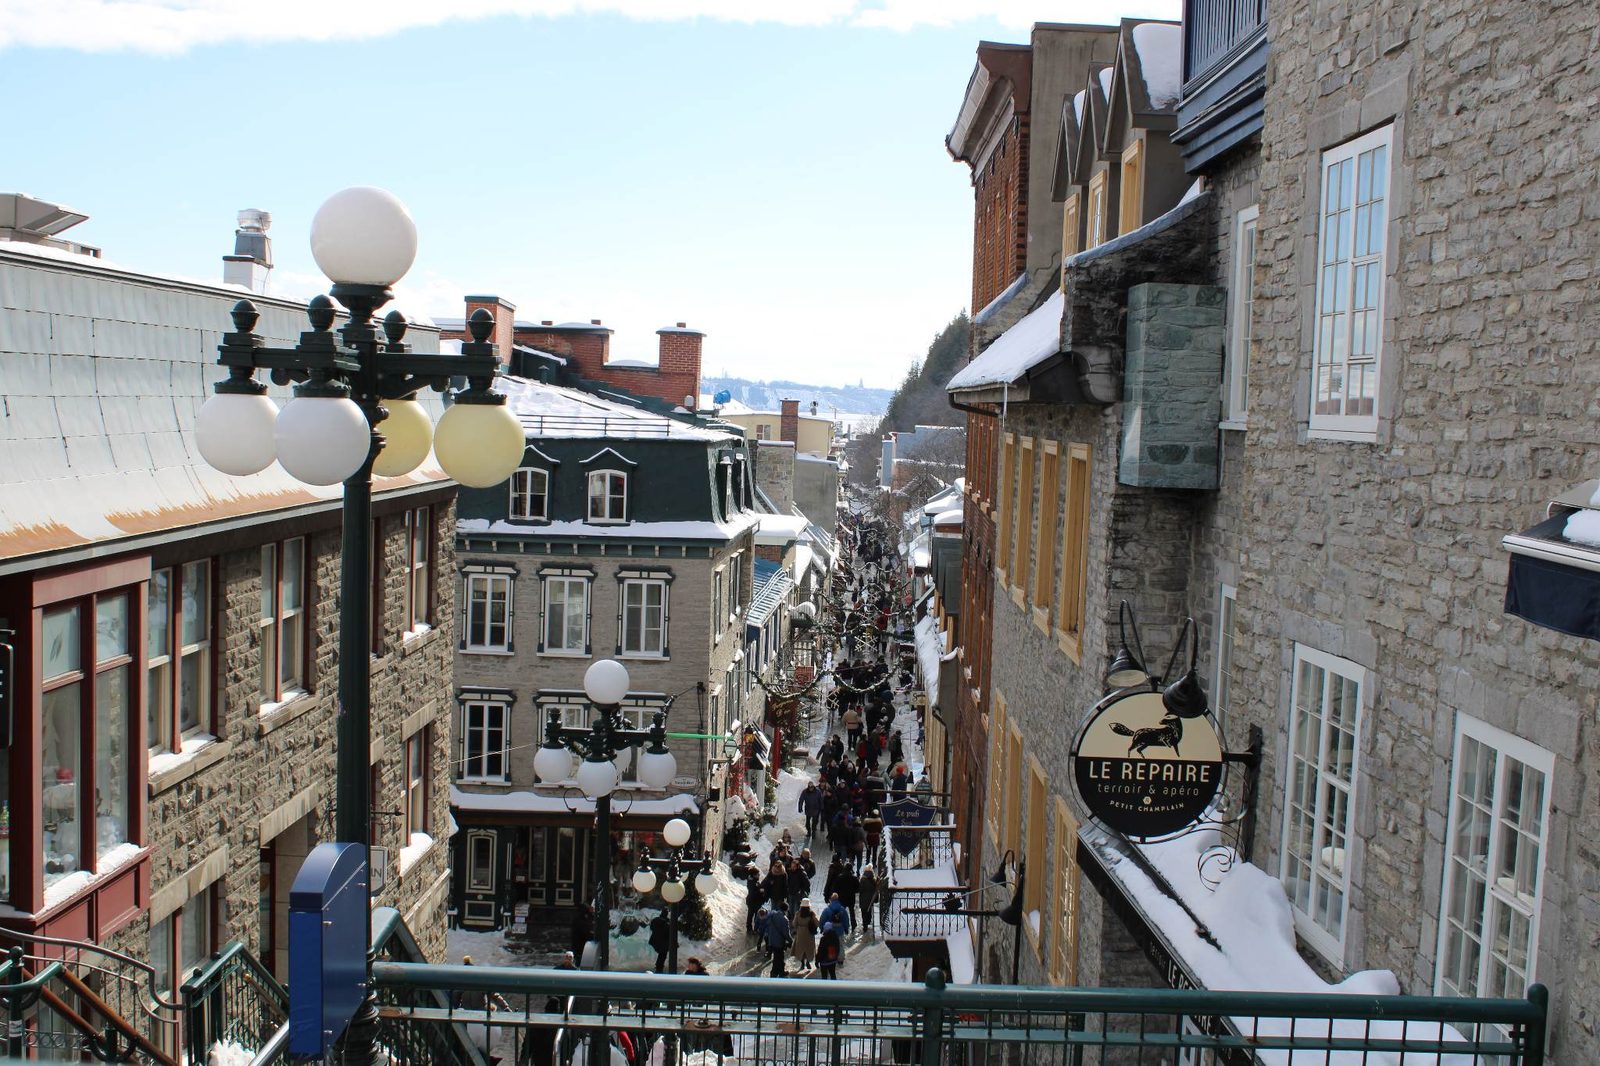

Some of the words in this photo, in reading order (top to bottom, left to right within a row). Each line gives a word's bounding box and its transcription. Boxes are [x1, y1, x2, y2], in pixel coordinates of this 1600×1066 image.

[1089, 761, 1111, 779] LE
[1122, 762, 1210, 782] REPAIRE
[1097, 783, 1142, 794] terroir
[1148, 784, 1156, 795] &
[1162, 785, 1199, 798] apéro
[1109, 800, 1134, 810] PETIT
[1138, 803, 1185, 812] CHAMPLAIN
[1168, 959, 1178, 989] LE
